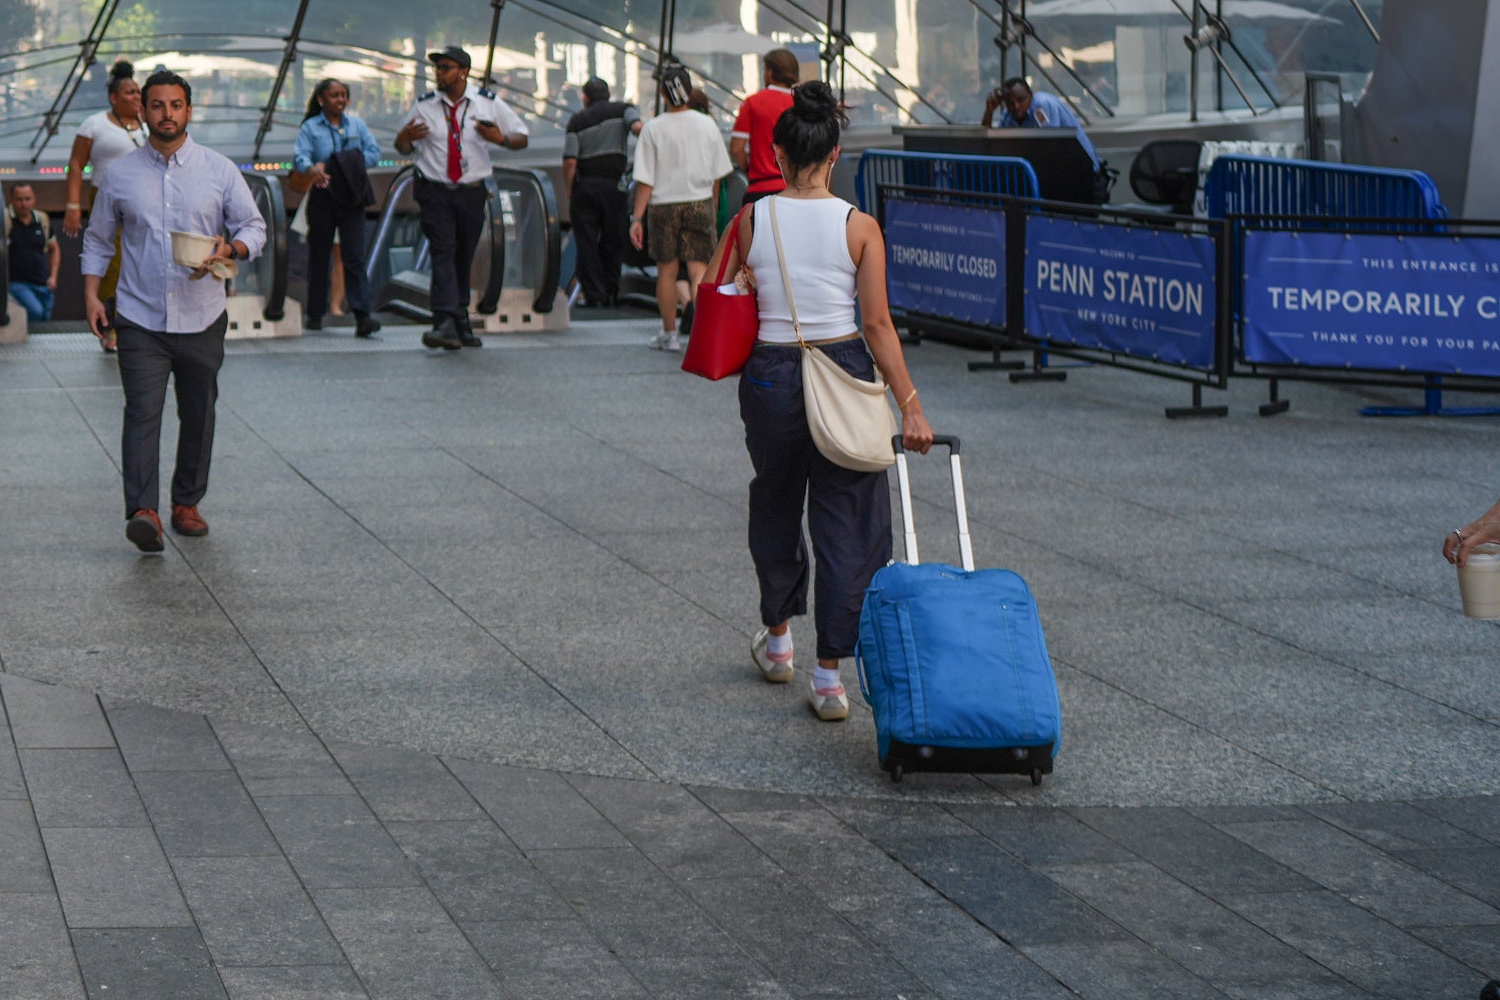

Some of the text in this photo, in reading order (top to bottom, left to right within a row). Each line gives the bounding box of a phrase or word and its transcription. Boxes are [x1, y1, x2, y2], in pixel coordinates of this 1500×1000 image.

[892, 244, 997, 279] TEMPORARILY CLOSED
[1362, 257, 1500, 274] THIS ENTRANCE IS
[1037, 259, 1203, 317] PENN STATION
[1267, 286, 1500, 320] TEMPORARILY C
[1077, 308, 1156, 332] NEW YORK CITY
[1312, 331, 1358, 344] THANK
[1366, 334, 1394, 346] YOU
[1402, 336, 1429, 347] FOR
[1437, 338, 1475, 350] YOUR
